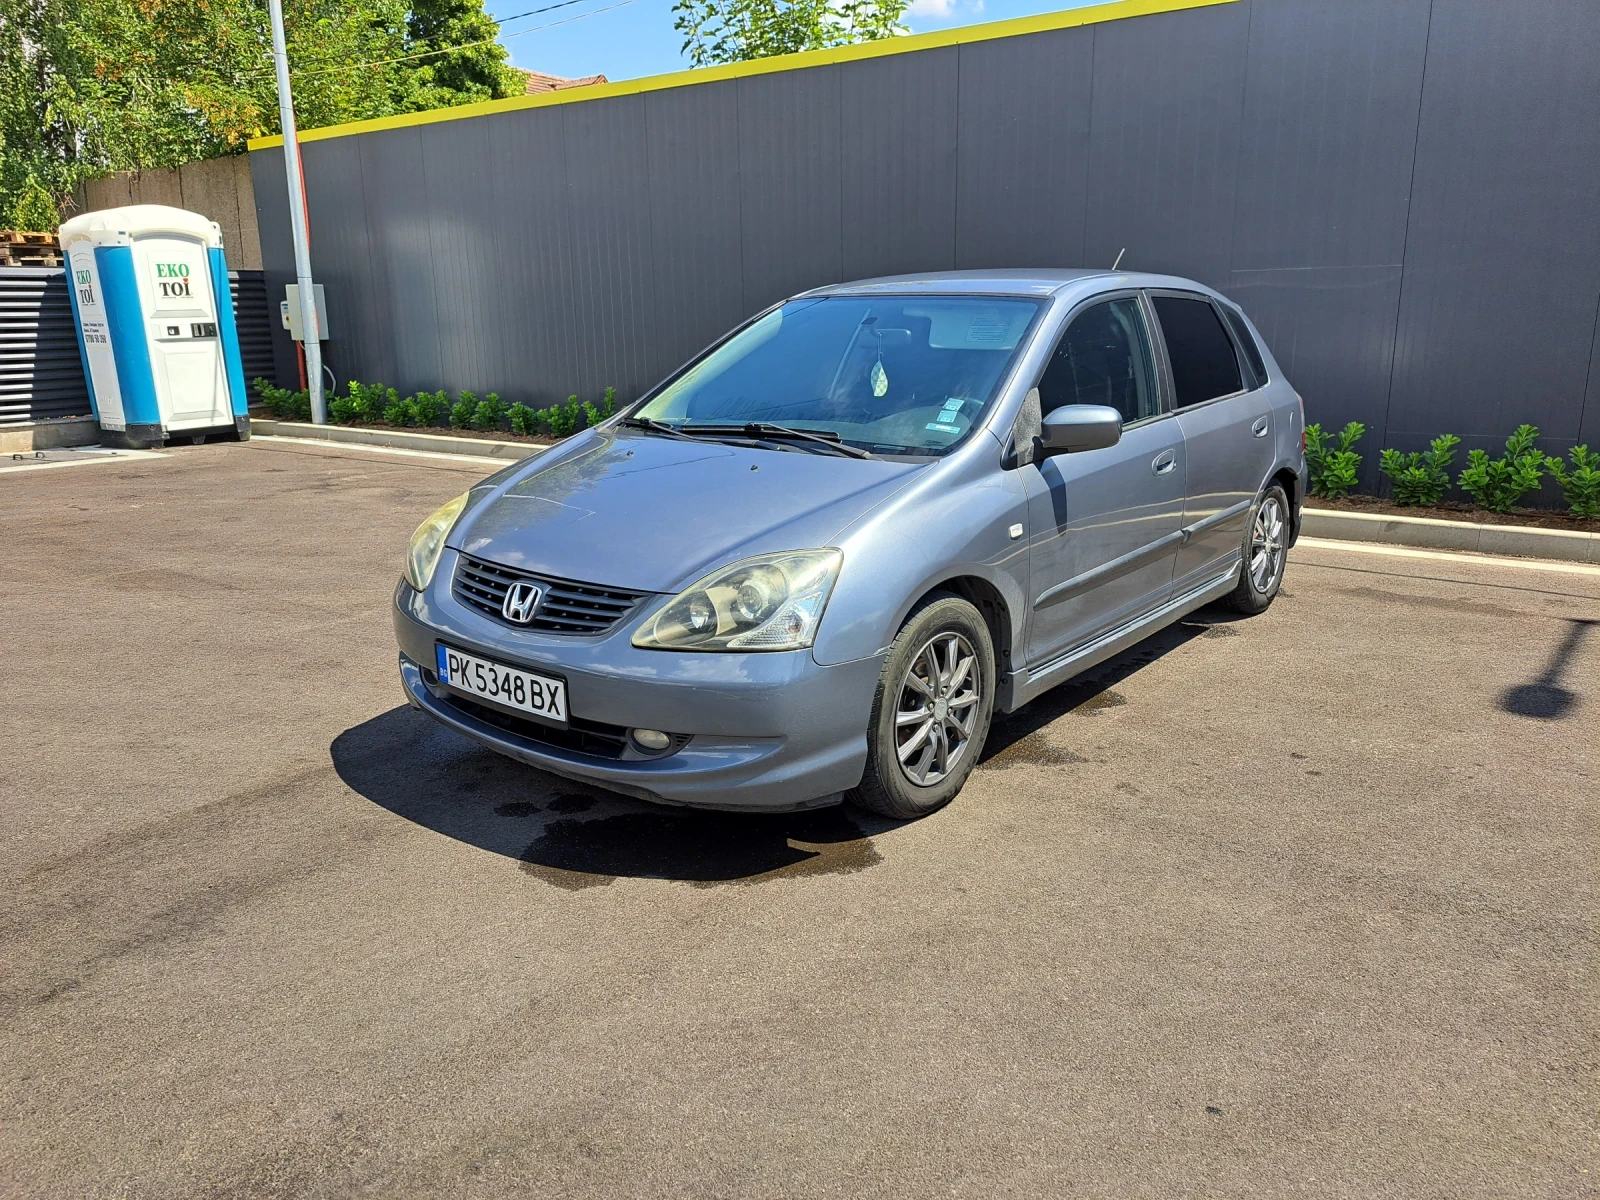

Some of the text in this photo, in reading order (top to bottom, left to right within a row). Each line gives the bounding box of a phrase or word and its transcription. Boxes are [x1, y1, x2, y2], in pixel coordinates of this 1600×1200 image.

[76, 269, 91, 284] EKO
[155, 263, 189, 277] EKO
[475, 663, 526, 705] 5348
